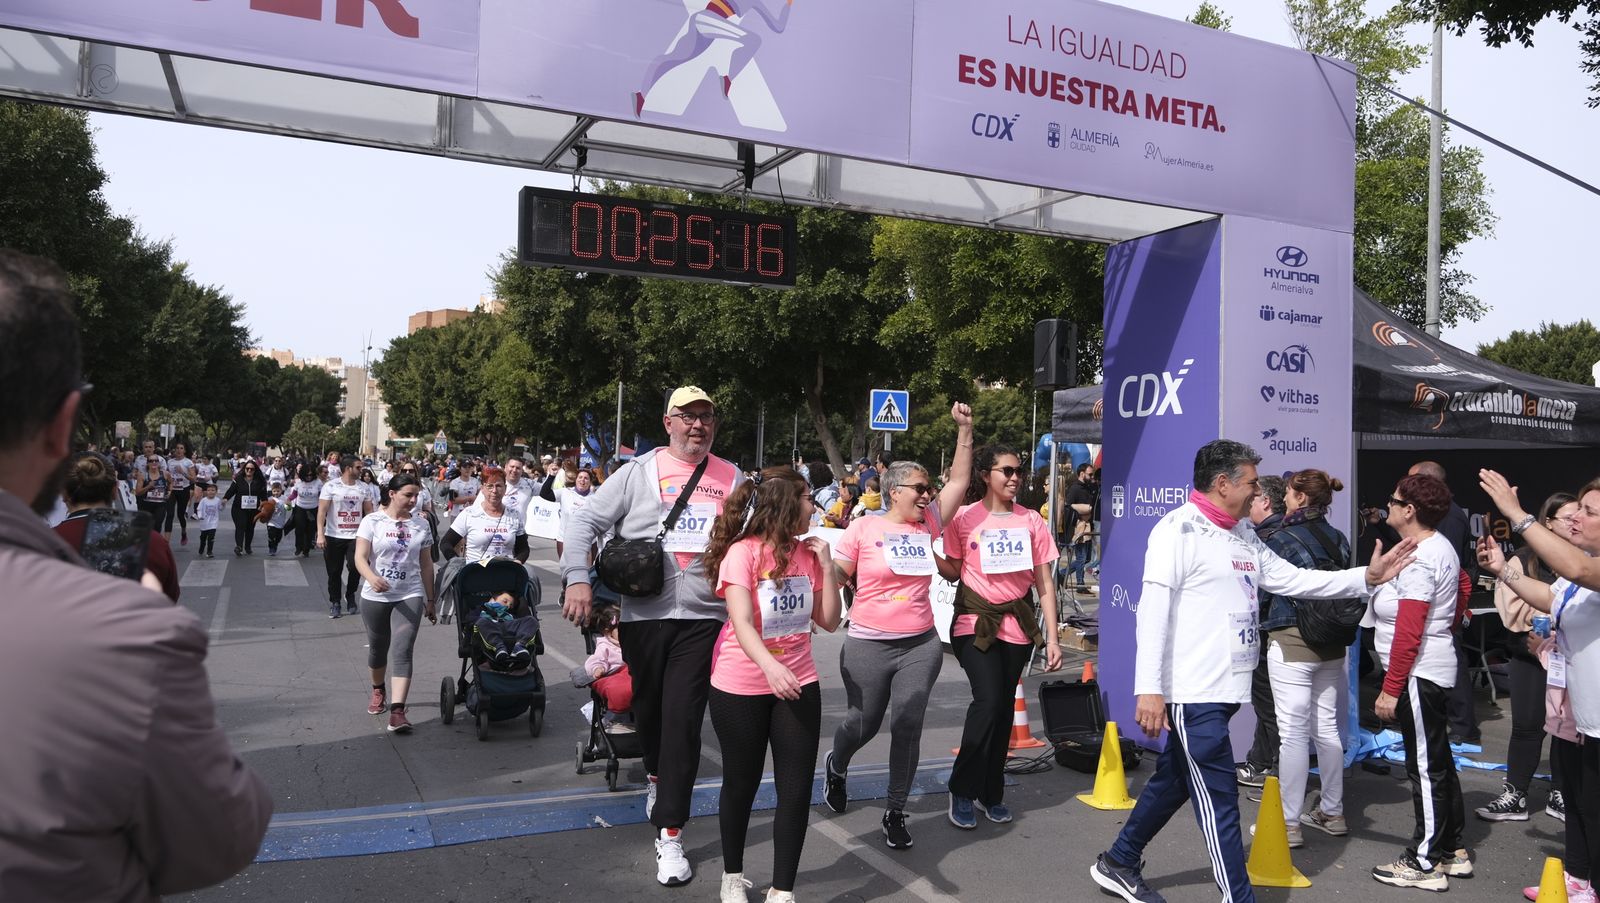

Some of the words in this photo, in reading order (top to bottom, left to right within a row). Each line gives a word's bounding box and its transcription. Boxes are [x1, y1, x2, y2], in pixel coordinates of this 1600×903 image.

[1008, 15, 1042, 50] LA
[1051, 25, 1187, 80] IGUALDAD
[958, 54, 997, 88] ES
[1005, 64, 1139, 118] NUESTRA
[1145, 92, 1226, 133] META.
[971, 112, 1016, 141] CDX
[1070, 127, 1120, 147] ALMERÍA
[1070, 142, 1096, 153] CIUDAD
[572, 201, 784, 277] 00:25:16
[1264, 267, 1320, 284] HYUNDAI
[1278, 309, 1323, 325] cajamar
[1266, 350, 1306, 374] CASI
[1118, 370, 1185, 418] CDX
[1279, 389, 1319, 405] vithas
[1490, 415, 1538, 428] cronometraje
[1539, 420, 1573, 431] deportivo
[1269, 437, 1317, 455] aqualia
[1135, 484, 1189, 504] ALMERÍ
[1134, 505, 1166, 517] CIUDAD
[677, 517, 708, 530] 307
[891, 545, 926, 557] 1308
[987, 541, 1024, 554] 1314
[380, 568, 407, 580] 1238
[1231, 560, 1256, 572] MUJER
[770, 593, 805, 612] 1301
